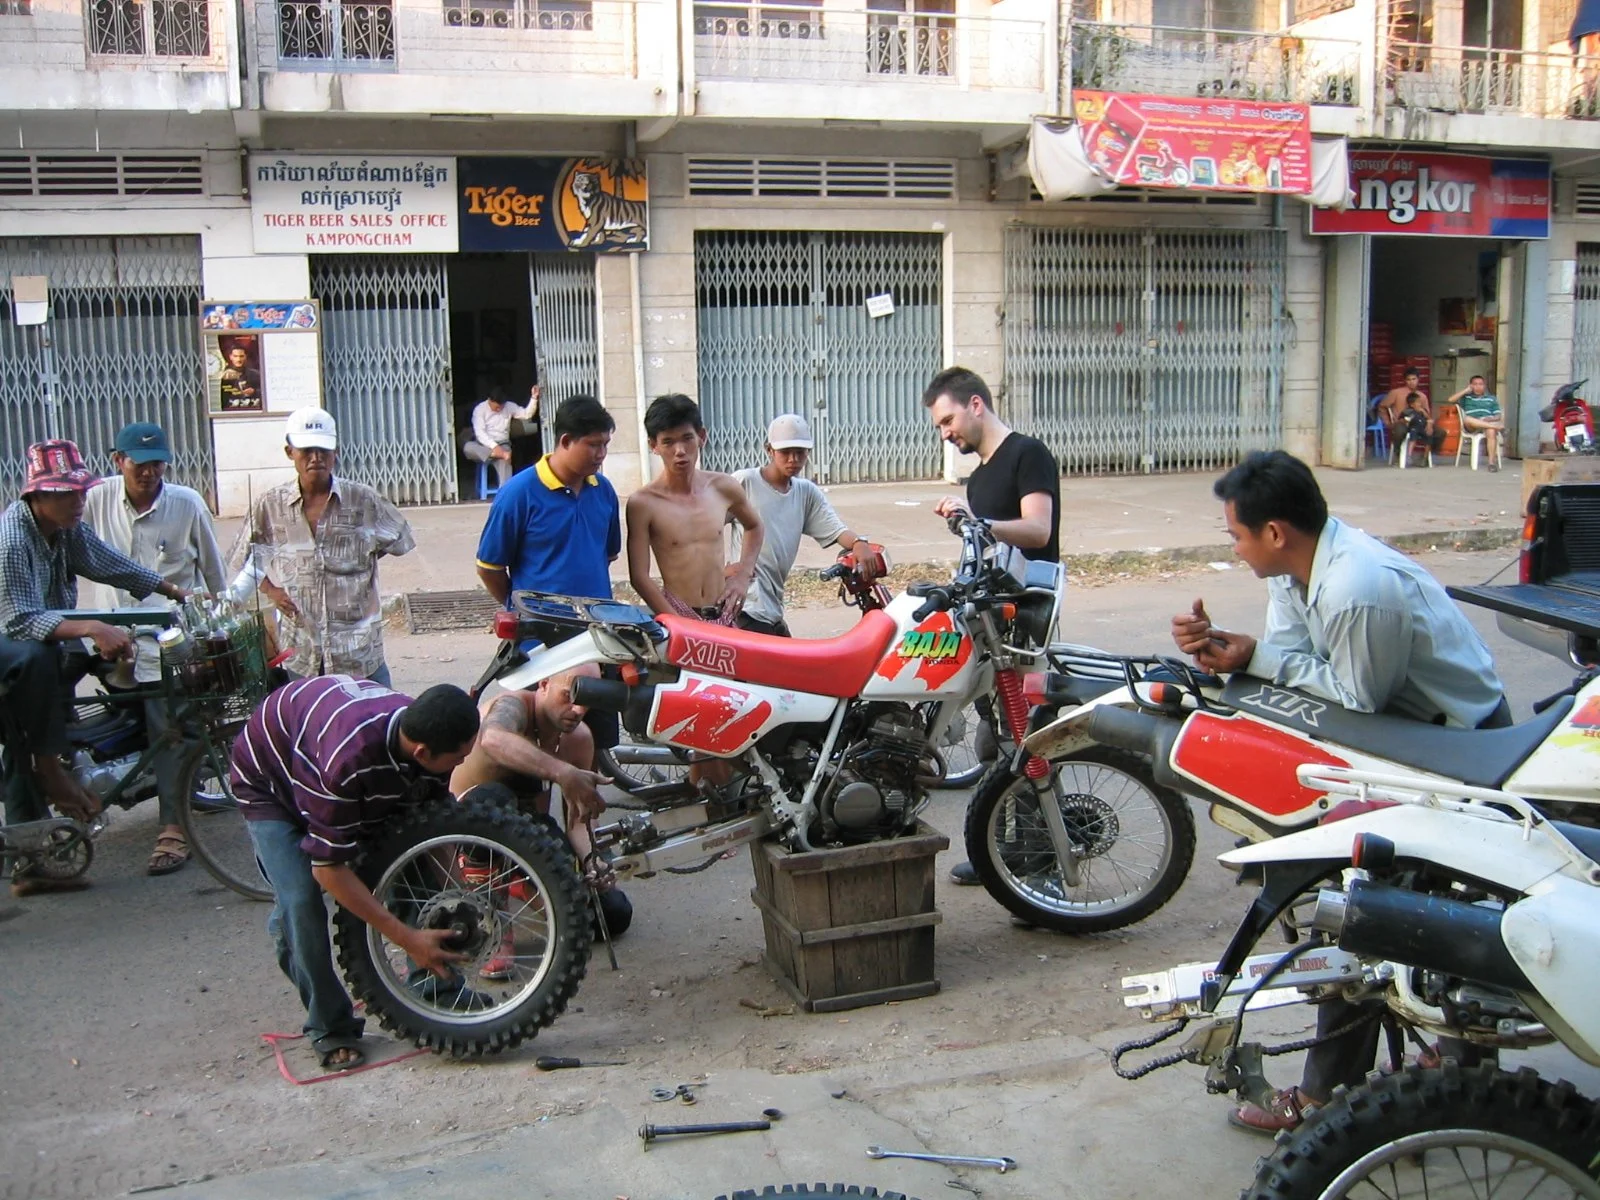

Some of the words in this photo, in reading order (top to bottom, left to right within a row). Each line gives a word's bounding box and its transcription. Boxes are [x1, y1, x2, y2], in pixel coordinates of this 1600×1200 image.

[464, 186, 545, 227] Tiger
[1318, 168, 1476, 224] ngkor
[263, 214, 305, 227] TIGER
[309, 214, 344, 227] BEER
[350, 214, 393, 227] SALES
[400, 214, 448, 227] OFFICE
[514, 215, 541, 226] Beer
[306, 233, 412, 246] KAMPONGCHAM
[676, 636, 737, 675] XLR
[897, 631, 962, 658] BAJA
[1240, 684, 1327, 728] XLR
